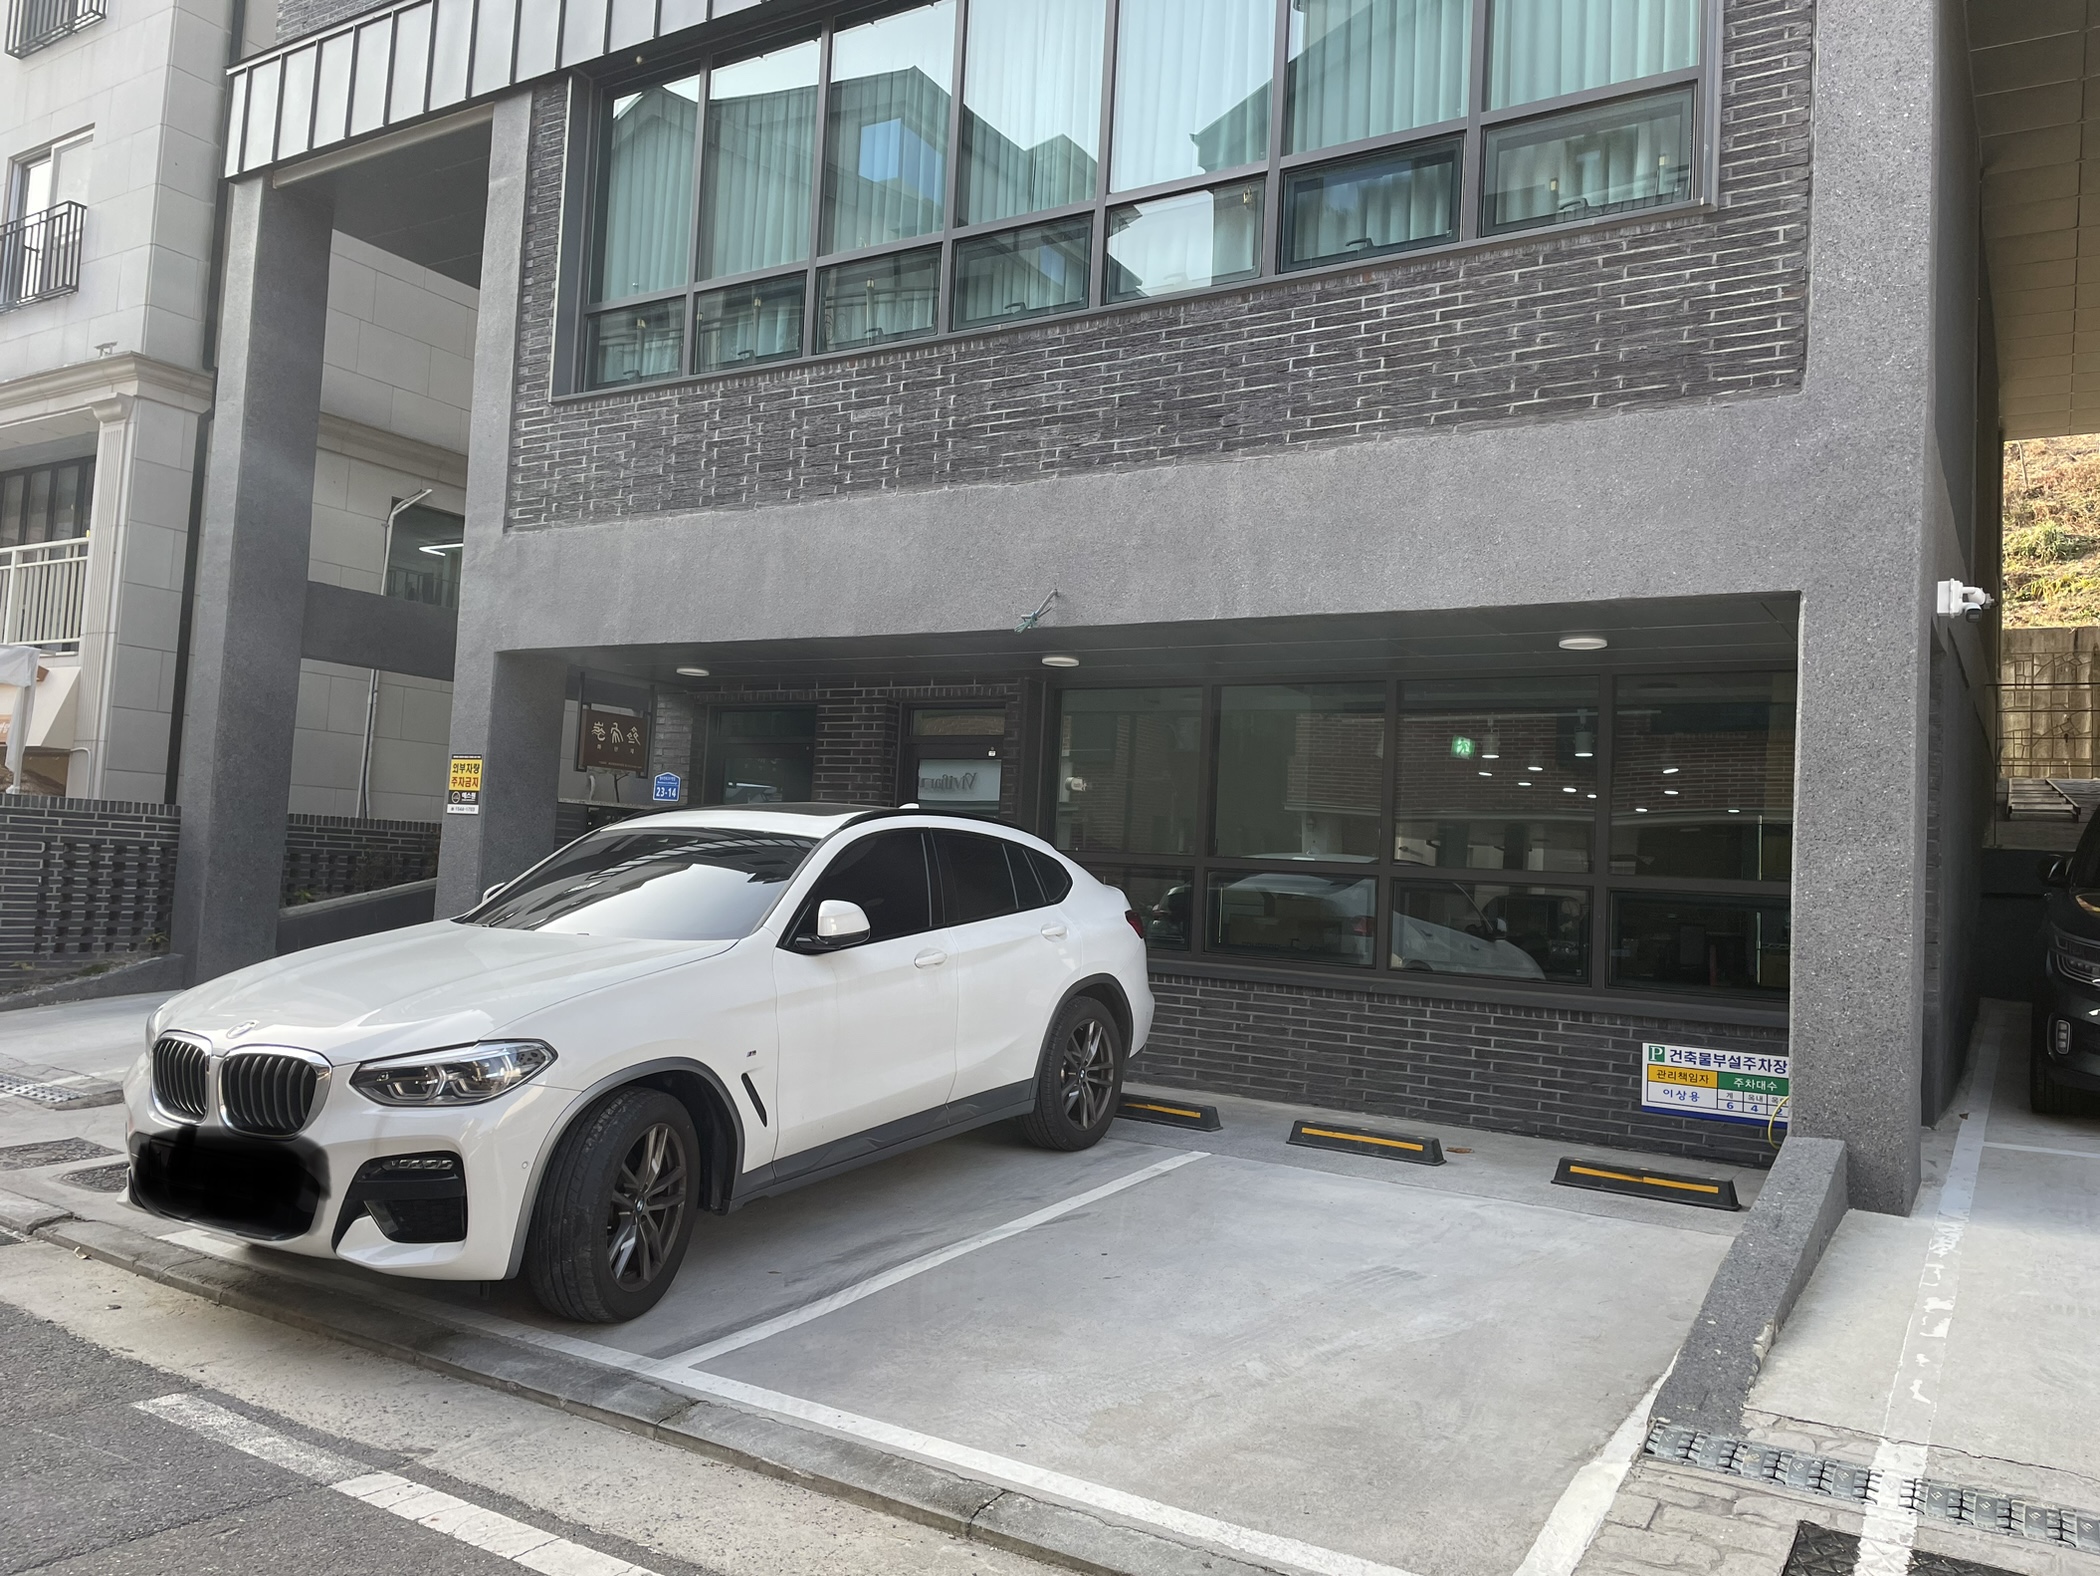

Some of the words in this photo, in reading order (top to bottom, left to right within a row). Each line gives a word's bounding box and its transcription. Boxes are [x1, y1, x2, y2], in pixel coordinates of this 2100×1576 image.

[656, 787, 676, 798] 23-14
[1650, 1046, 1663, 1061] P
[1670, 1049, 1788, 1074] 건축물부설주차장
[1656, 1069, 1709, 1084] 관리책임자
[1733, 1077, 1778, 1092] 주차대수
[1748, 1094, 1764, 1103] 옥내
[1726, 1102, 1734, 1110] 6
